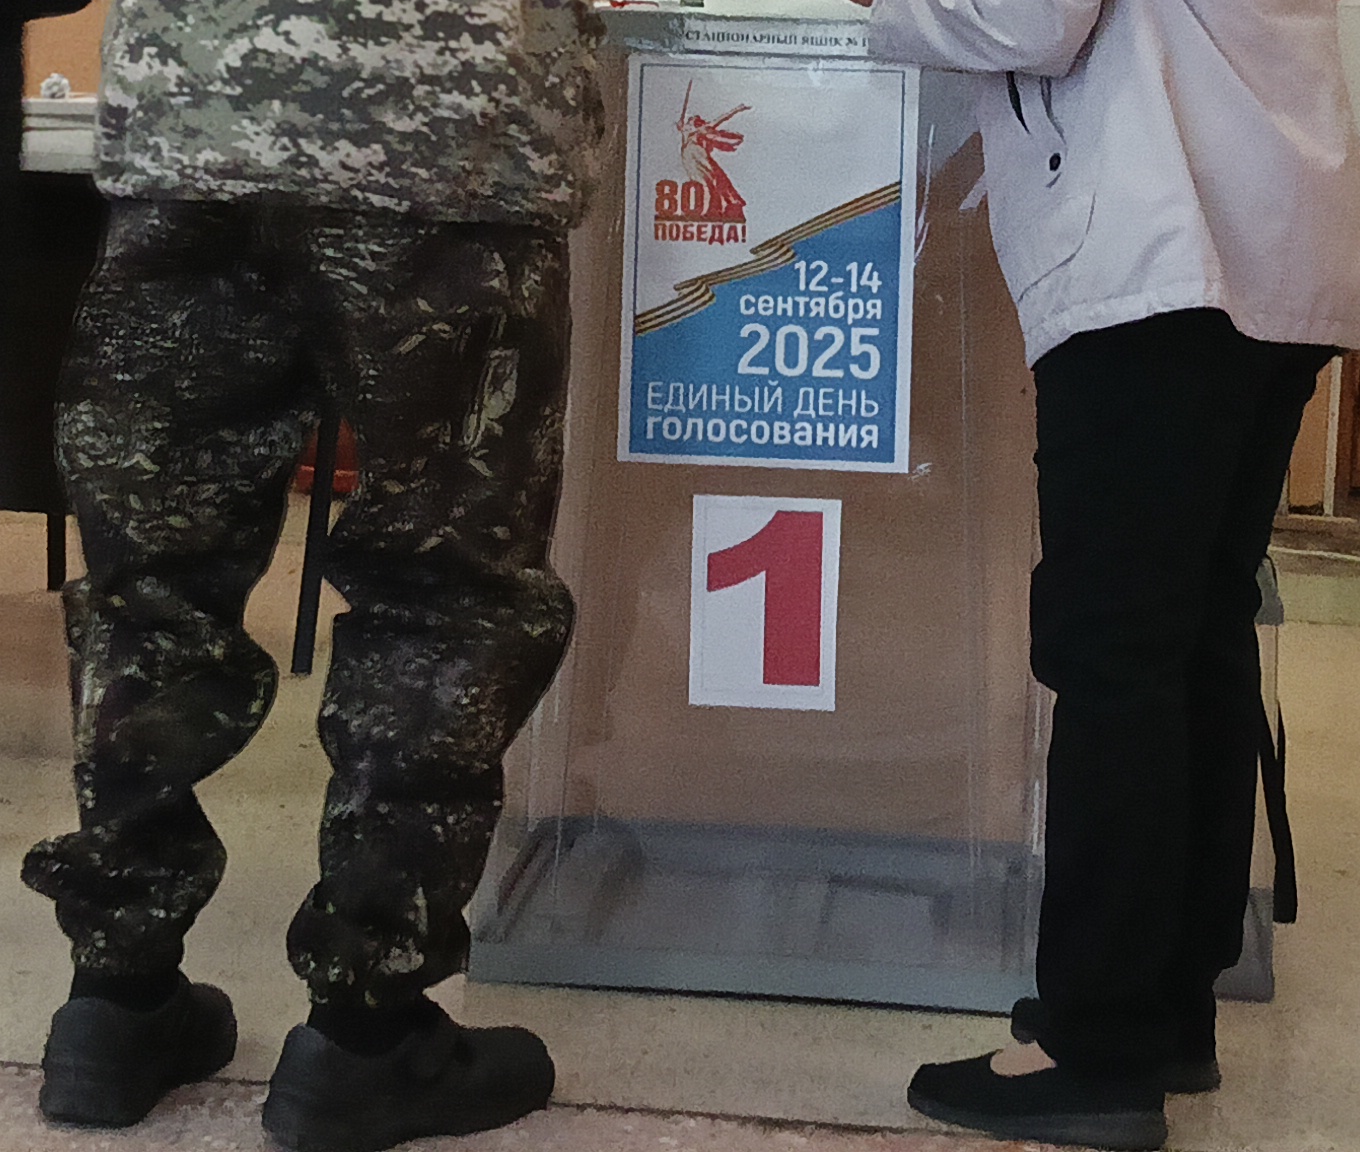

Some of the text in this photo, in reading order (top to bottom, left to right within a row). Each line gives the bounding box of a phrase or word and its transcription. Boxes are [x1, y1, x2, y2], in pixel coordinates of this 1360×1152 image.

[655, 179, 705, 216] 80
[654, 222, 747, 246] ПОБЕДА!
[793, 260, 882, 294] 12-14
[739, 293, 883, 324] сентября
[736, 323, 882, 381] 2025
[646, 380, 880, 420] ЕДИНЫЙ ДЕНЬ
[645, 415, 879, 449] голосования
[706, 510, 824, 686] 1
